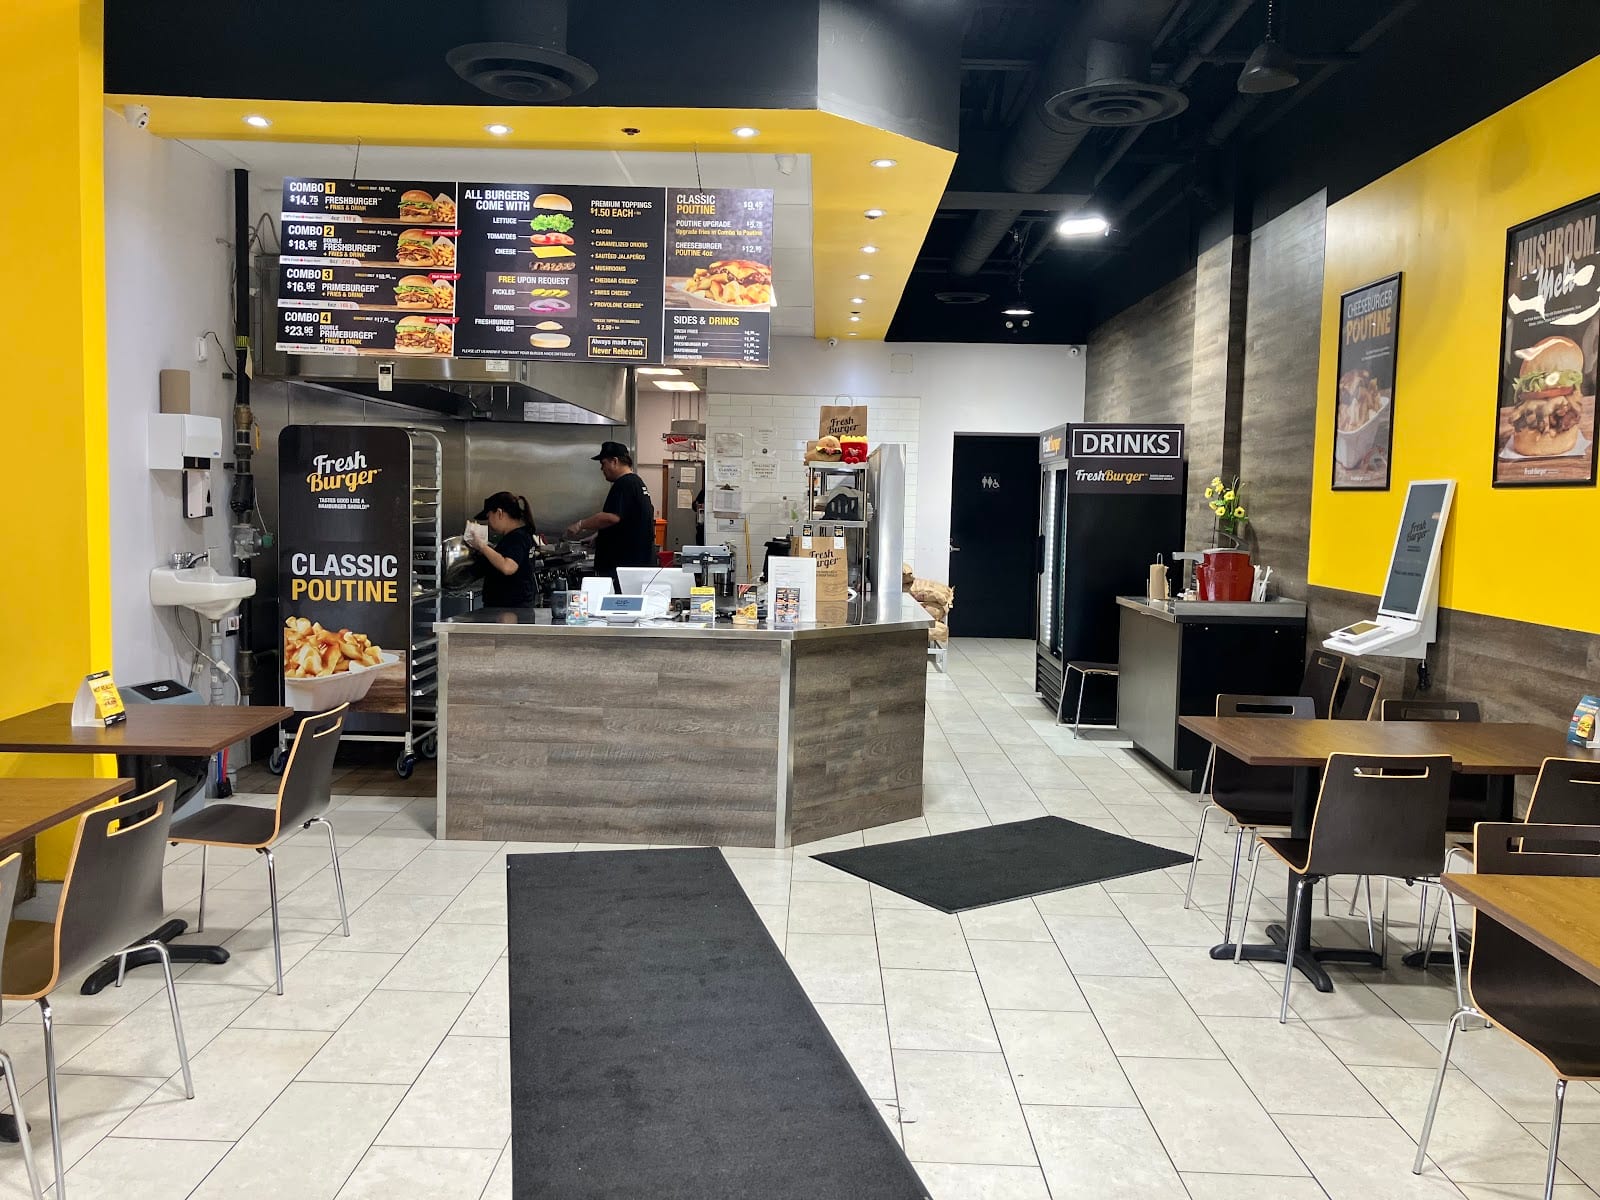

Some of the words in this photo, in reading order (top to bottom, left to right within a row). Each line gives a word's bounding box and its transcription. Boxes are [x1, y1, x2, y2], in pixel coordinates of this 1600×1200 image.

[290, 182, 324, 192] COMBO
[290, 195, 318, 205] $14.75
[465, 190, 482, 200] ALL
[485, 190, 530, 201] BURGERS
[676, 194, 716, 204] CLASSIC
[476, 200, 505, 210] COME
[506, 201, 530, 211] WITH
[677, 205, 716, 214] POUTINE
[591, 208, 610, 217] $1.50
[612, 208, 633, 217] EACH
[288, 225, 322, 235] COMBO
[288, 240, 317, 250] $18.95
[1517, 215, 1596, 278] MUSHROOM
[287, 269, 320, 279] COMBO
[287, 282, 315, 292] $16.95
[1348, 290, 1392, 318] CHEESEBURGER
[285, 312, 319, 322] COMBO
[674, 316, 697, 324] SIDES
[700, 316, 706, 324] &
[709, 316, 740, 326] DRINKS
[285, 325, 313, 336] $23.95
[1346, 307, 1392, 345] POUTINE
[830, 416, 854, 427] Fresh
[828, 424, 859, 434] Burger
[1082, 434, 1170, 454] DRINKS
[313, 450, 367, 474] Fresh
[306, 469, 378, 492] Burger
[1076, 470, 1144, 484] FreshBurger
[810, 549, 834, 558] Fresh
[291, 552, 398, 577] CLASSIC
[816, 558, 838, 568] urger
[292, 579, 398, 603] POUTINE
